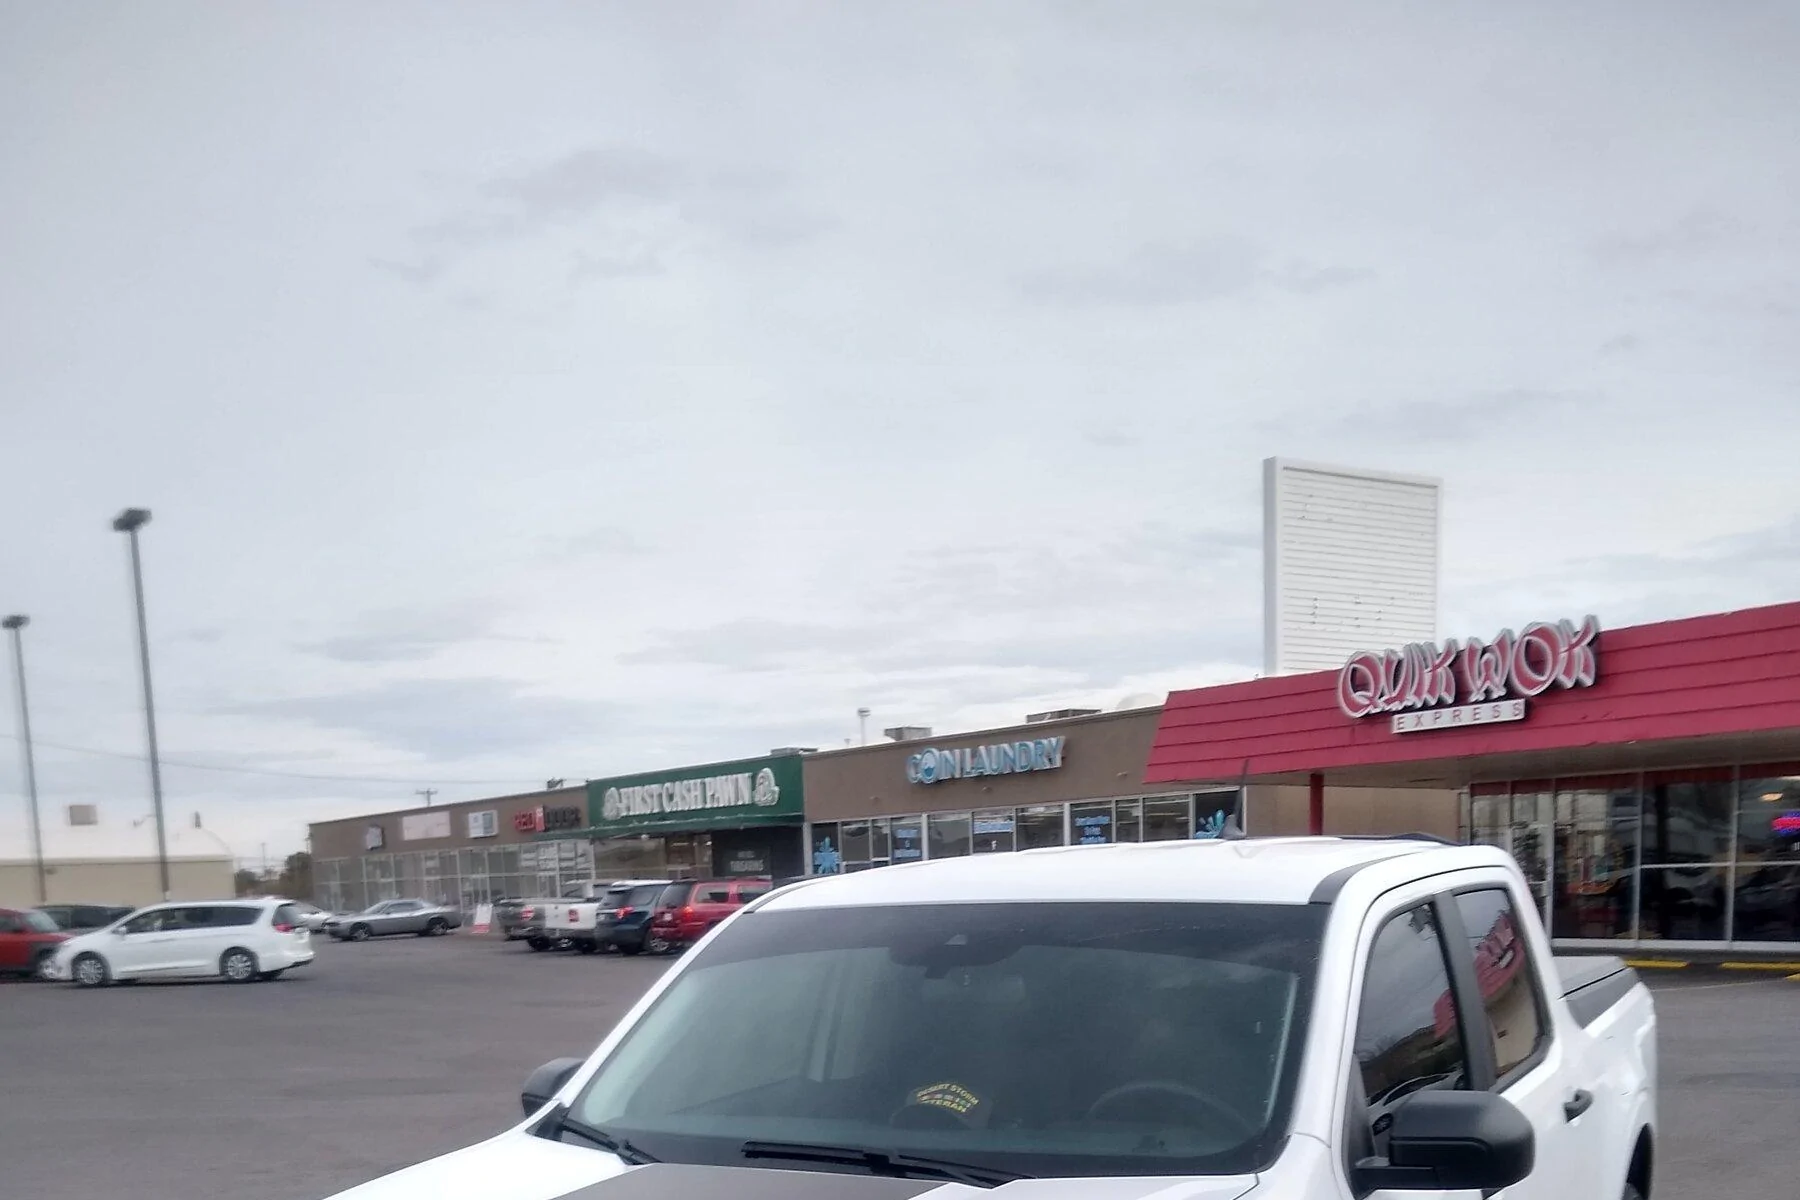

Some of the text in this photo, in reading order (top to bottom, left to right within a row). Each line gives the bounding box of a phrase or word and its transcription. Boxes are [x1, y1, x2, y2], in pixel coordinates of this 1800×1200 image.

[1338, 613, 1600, 719] QUIK WOK
[1396, 701, 1524, 731] EXPRESS
[906, 735, 1066, 784] COIN LAUNDRY
[618, 772, 753, 817] FIRST CASH PAWN
[950, 1084, 980, 1106] STORM
